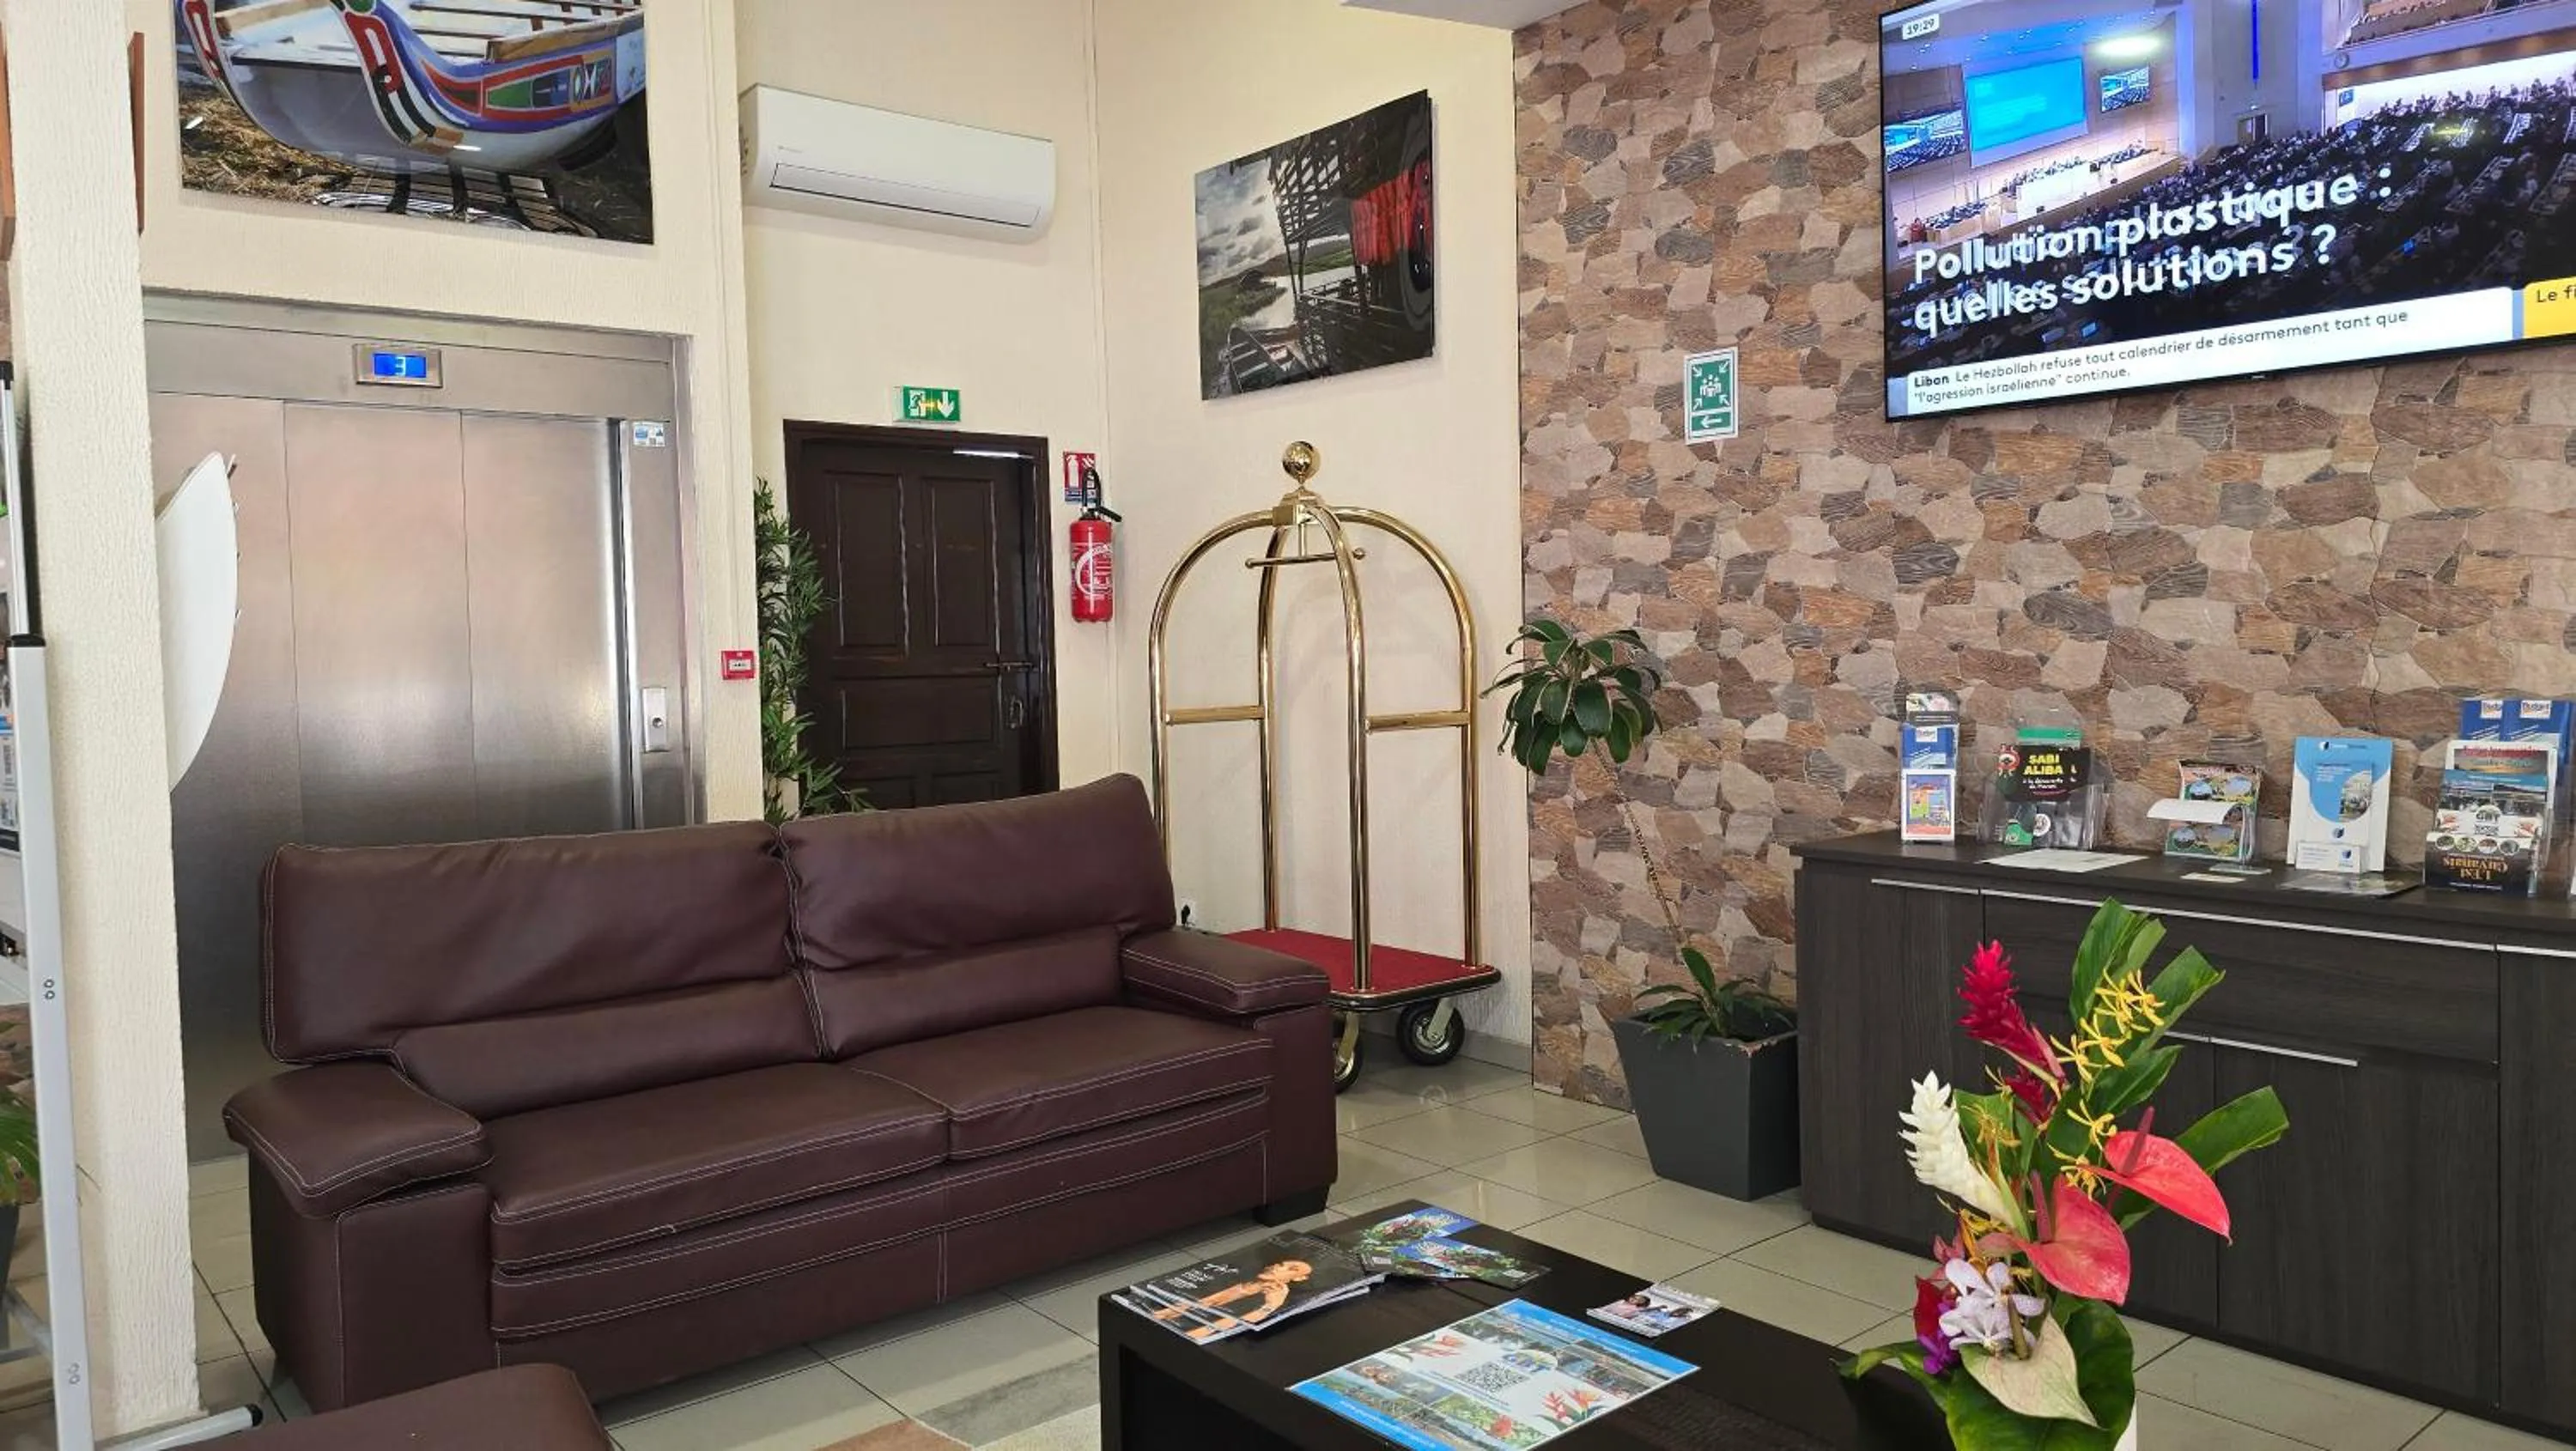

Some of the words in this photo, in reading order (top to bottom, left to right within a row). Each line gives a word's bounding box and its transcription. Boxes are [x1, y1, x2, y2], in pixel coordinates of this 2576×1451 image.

[1906, 18, 1935, 35] 19:29
[1914, 222, 2101, 285] Pollution
[2116, 173, 2359, 259] plastique
[1914, 273, 2060, 338] quelles
[2070, 237, 2295, 306] solutions
[2310, 223, 2339, 265] ?
[2537, 288, 2558, 303] Le
[1914, 374, 1950, 388] Liban
[1955, 370, 1971, 383] Le
[1974, 361, 2038, 379] Hezbollah
[2040, 355, 2082, 371] refuse
[2086, 351, 2115, 366] tout
[2118, 337, 2191, 361] calendrier
[2195, 336, 2214, 350] de
[2218, 319, 2330, 346] désarmement
[2335, 314, 2372, 331] tant
[2375, 310, 2409, 329] que
[395, 355, 407, 376] 3
[2065, 367, 2131, 385] continue.
[2028, 754, 2060, 765] SABI
[2023, 764, 2064, 776] ALIBA
